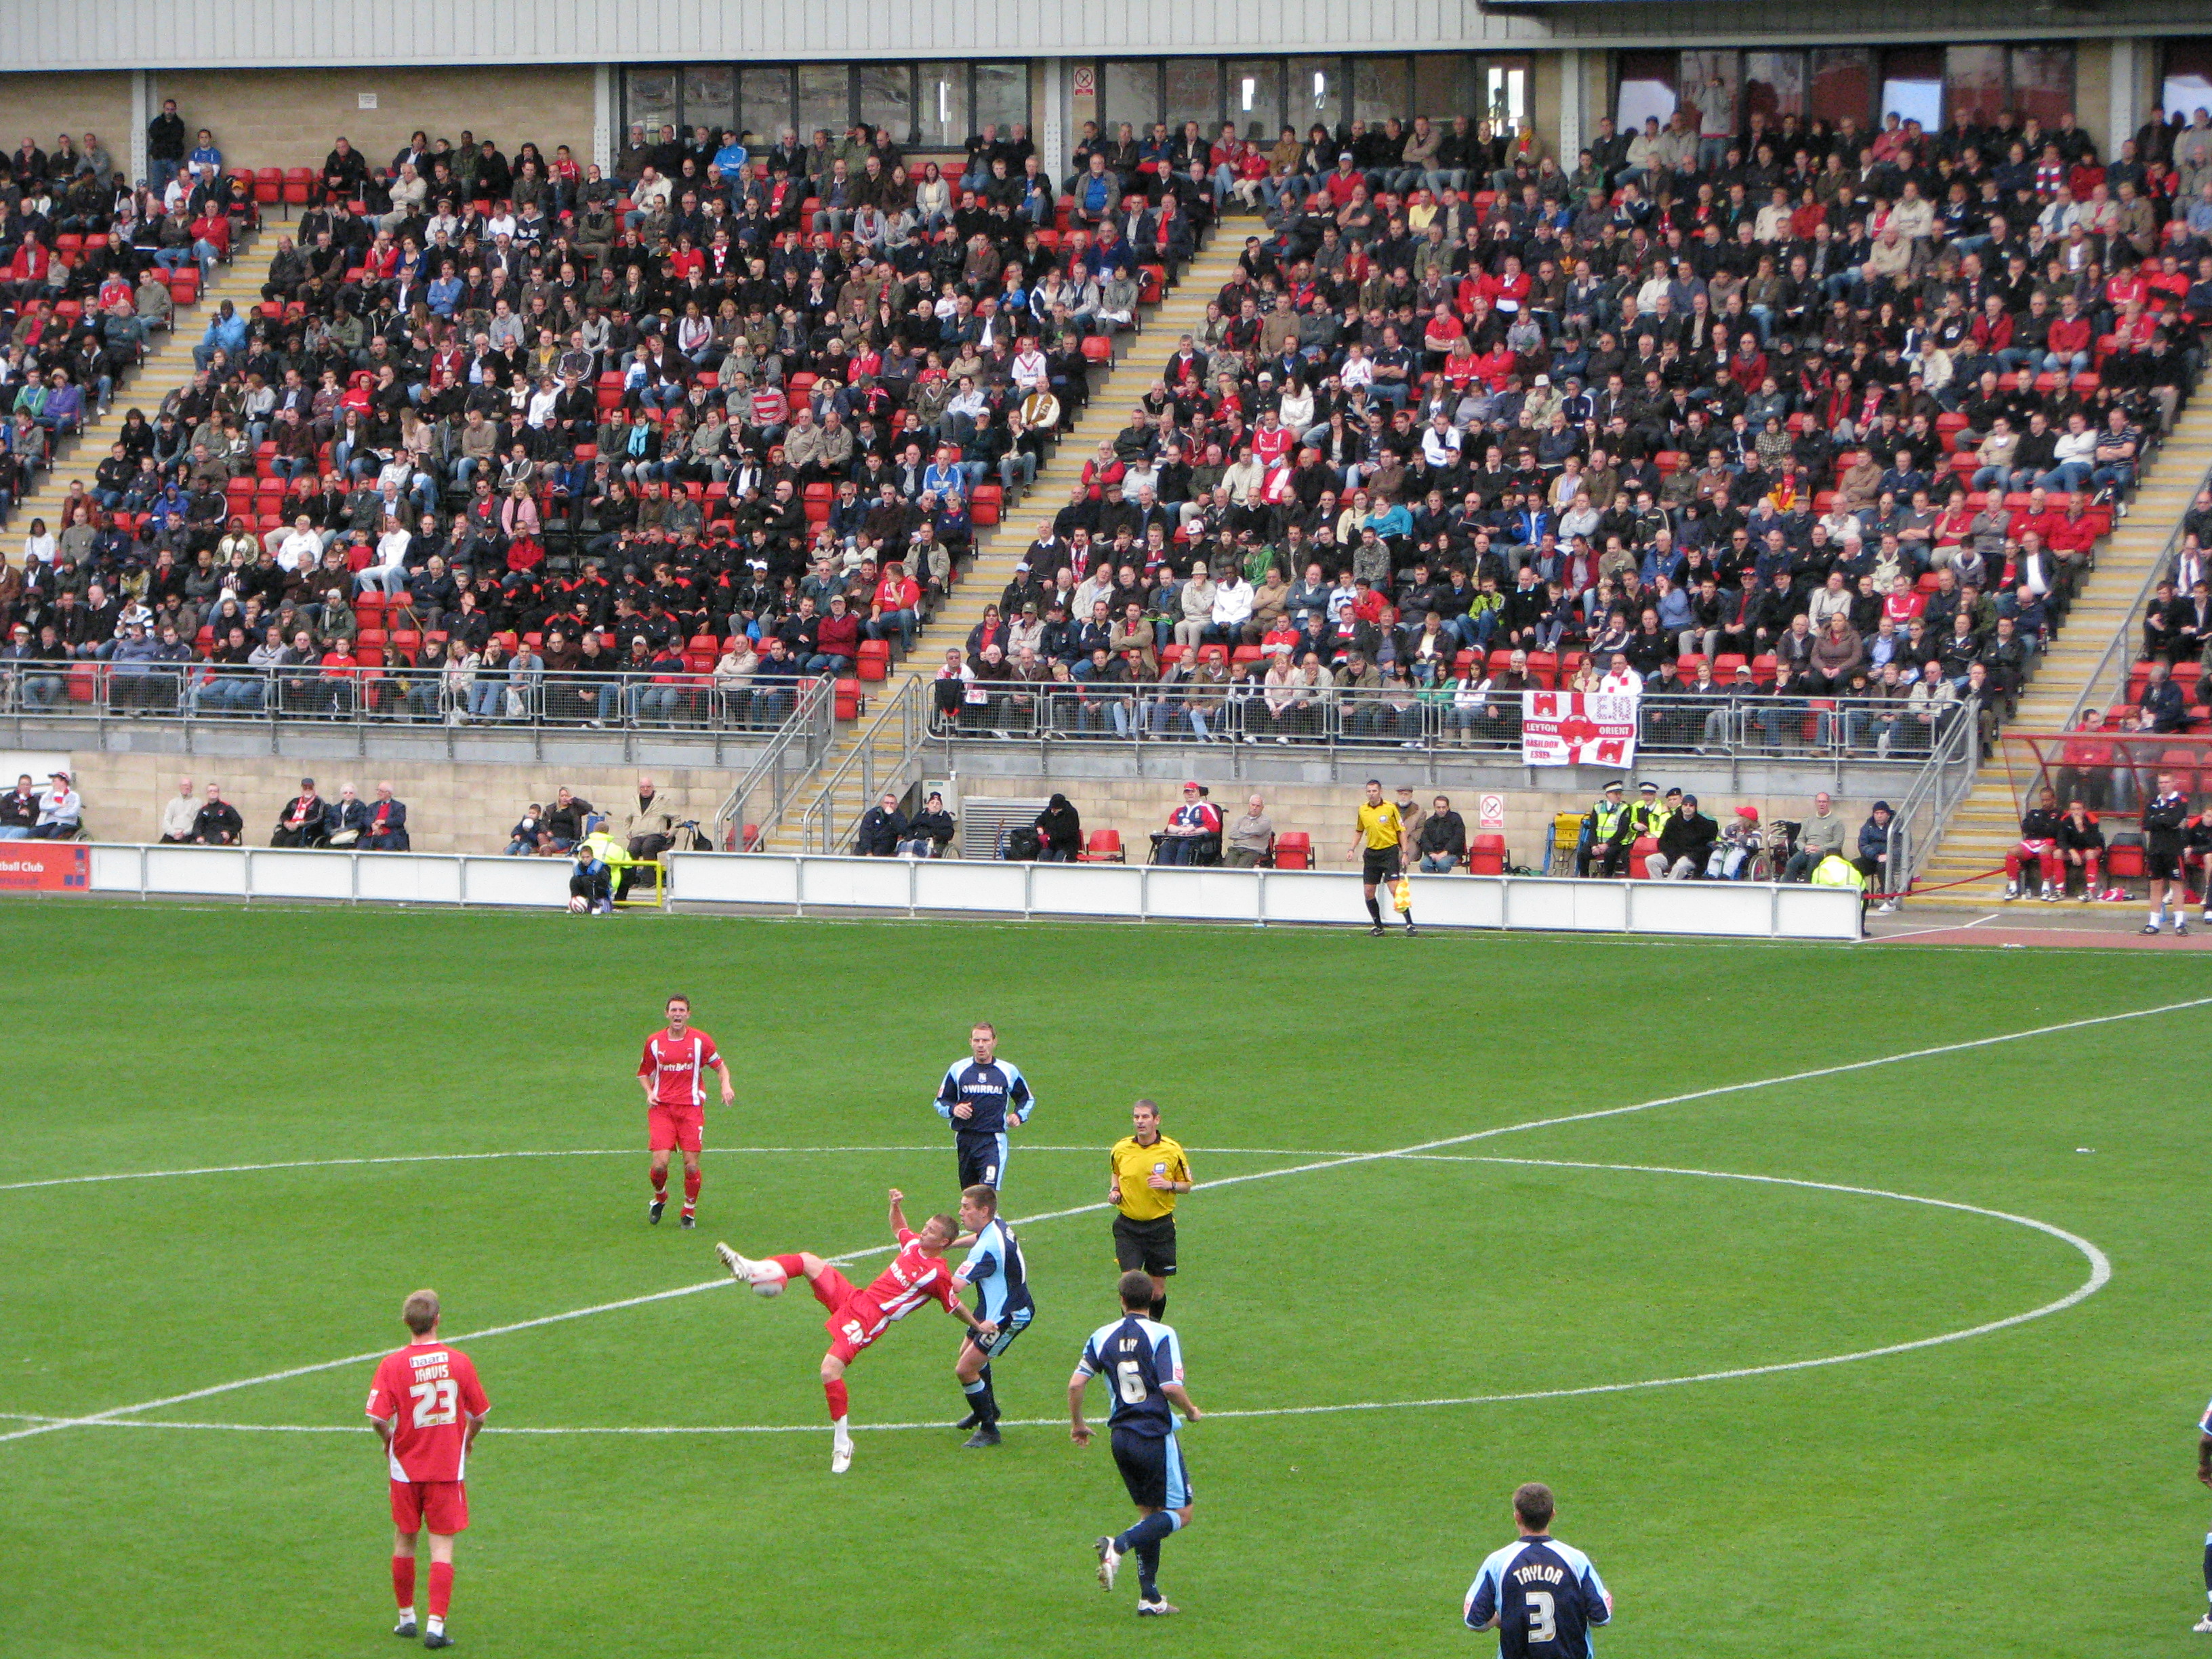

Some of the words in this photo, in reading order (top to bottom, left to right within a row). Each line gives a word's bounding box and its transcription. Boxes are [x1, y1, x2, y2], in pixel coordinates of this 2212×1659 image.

[1526, 722, 1557, 733] LEYTON
[1599, 726, 1630, 735] ORIENT
[1525, 739, 1559, 749] BASILDON
[1530, 750, 1551, 759] ESSEX
[21, 861, 45, 873] Club
[968, 1084, 1003, 1094] WIRRAL
[986, 1165, 996, 1181] 9
[841, 1319, 865, 1345] 20
[411, 1353, 448, 1367] haart
[415, 1364, 449, 1383] JARVIS
[1117, 1360, 1147, 1404] 6
[409, 1378, 458, 1429] 23
[1513, 1565, 1564, 1585] TAYLOR
[1525, 1591, 1557, 1643] 3
